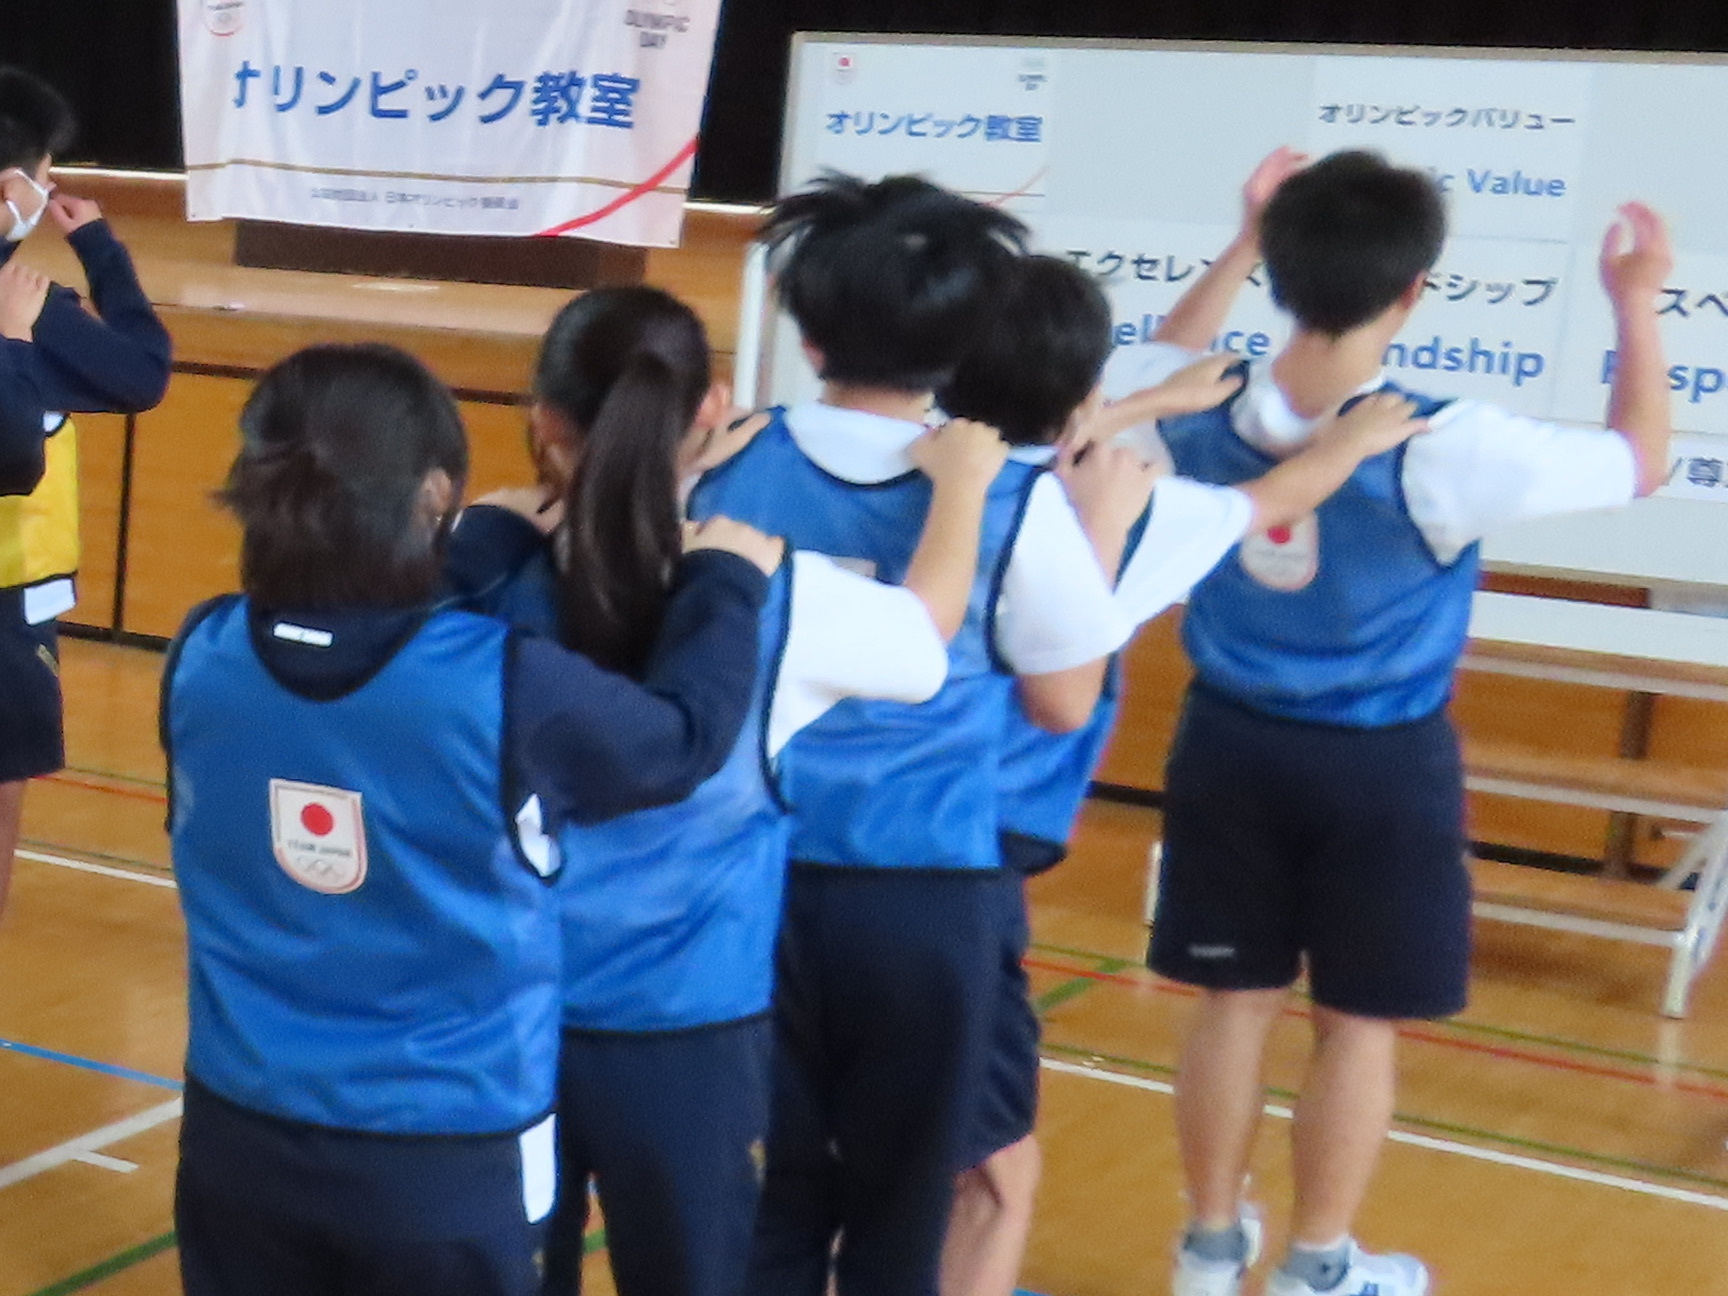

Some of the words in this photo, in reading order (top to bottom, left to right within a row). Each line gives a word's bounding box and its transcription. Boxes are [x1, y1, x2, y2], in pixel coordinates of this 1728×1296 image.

[1318, 103, 1576, 130] オリンピックバリュー
[1466, 167, 1567, 198] Value
